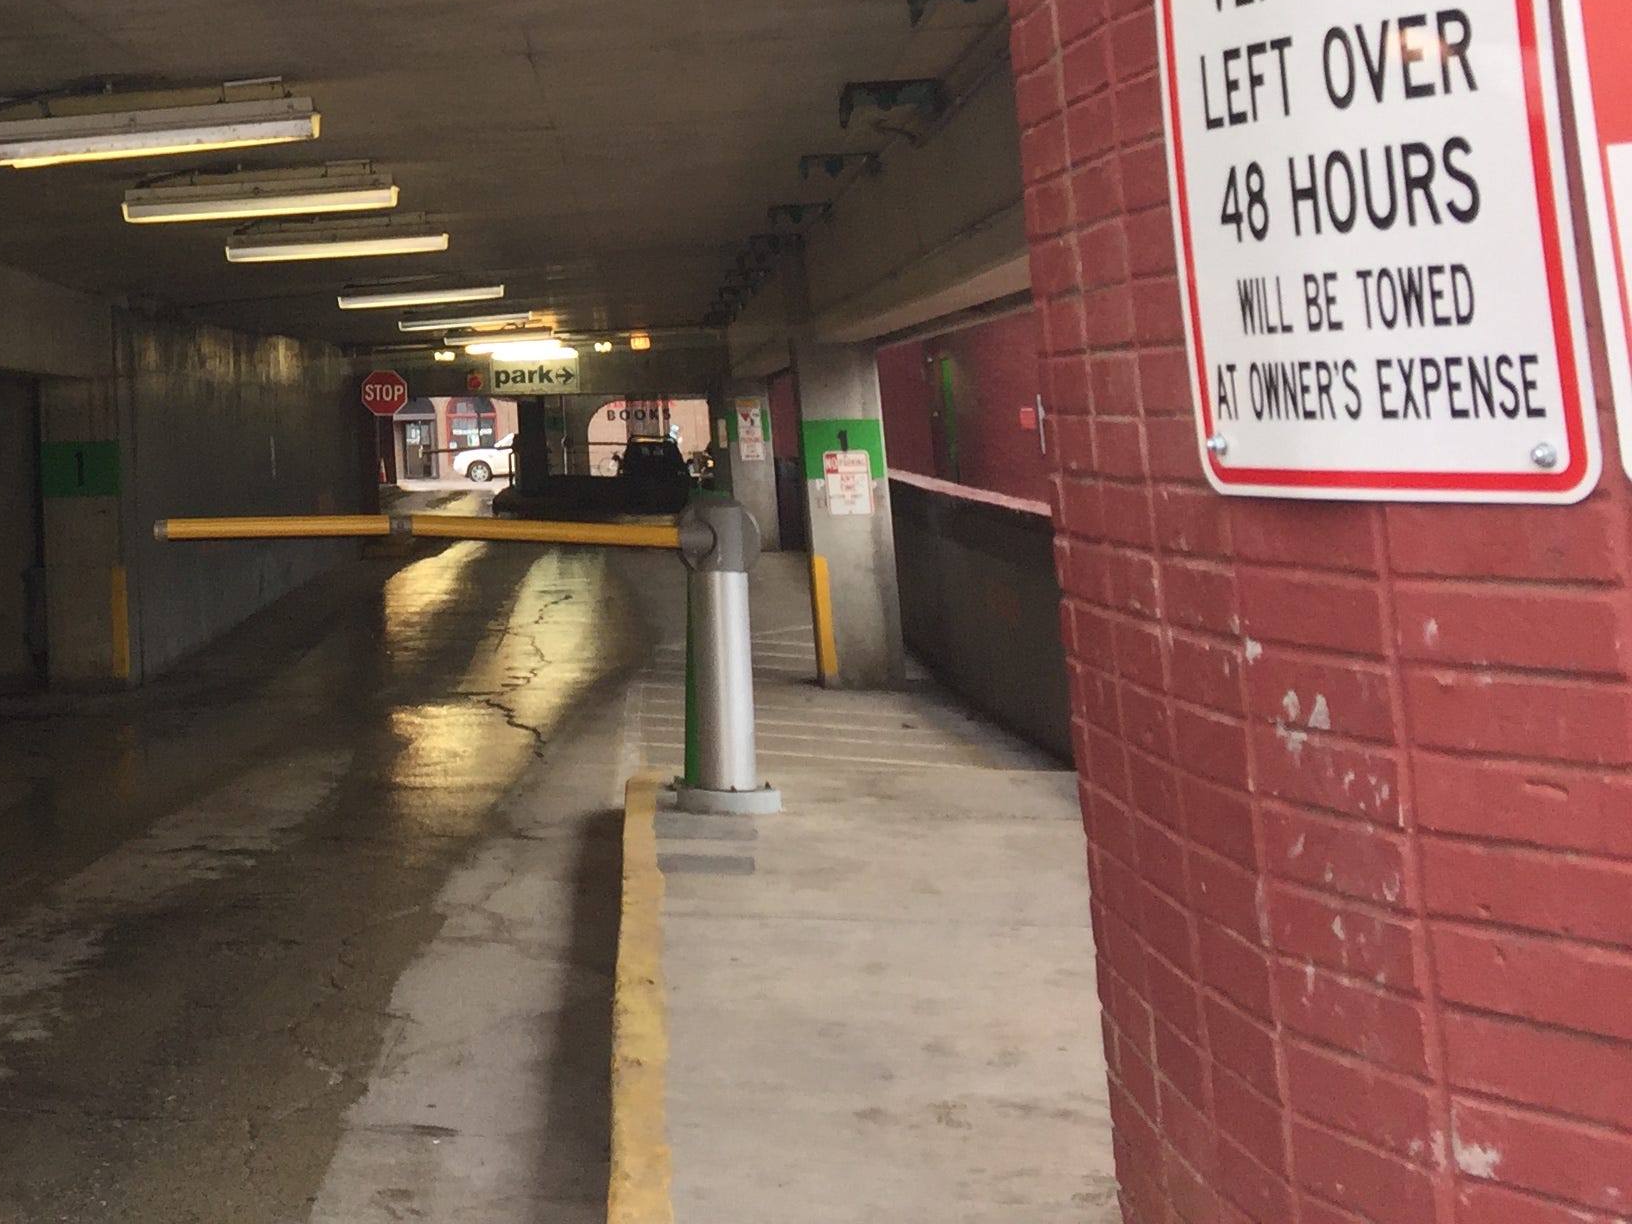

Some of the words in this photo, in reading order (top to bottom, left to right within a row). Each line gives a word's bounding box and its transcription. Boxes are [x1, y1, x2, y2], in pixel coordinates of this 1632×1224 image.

[1200, 35, 1294, 131] LEFT
[1322, 8, 1479, 110] OVER
[1220, 160, 1270, 243] 48
[1288, 135, 1481, 237] HOURS
[1236, 274, 1294, 336] WILL
[1302, 271, 1345, 333] BE
[1355, 263, 1476, 330] TOWED
[364, 384, 404, 402] STOP
[494, 364, 555, 389] park
[1217, 363, 1239, 421] AT
[1248, 358, 1363, 422] OWNER'S
[1375, 353, 1547, 421] EXPENSE
[606, 407, 671, 421] BOOKS
[73, 450, 85, 488] 1
